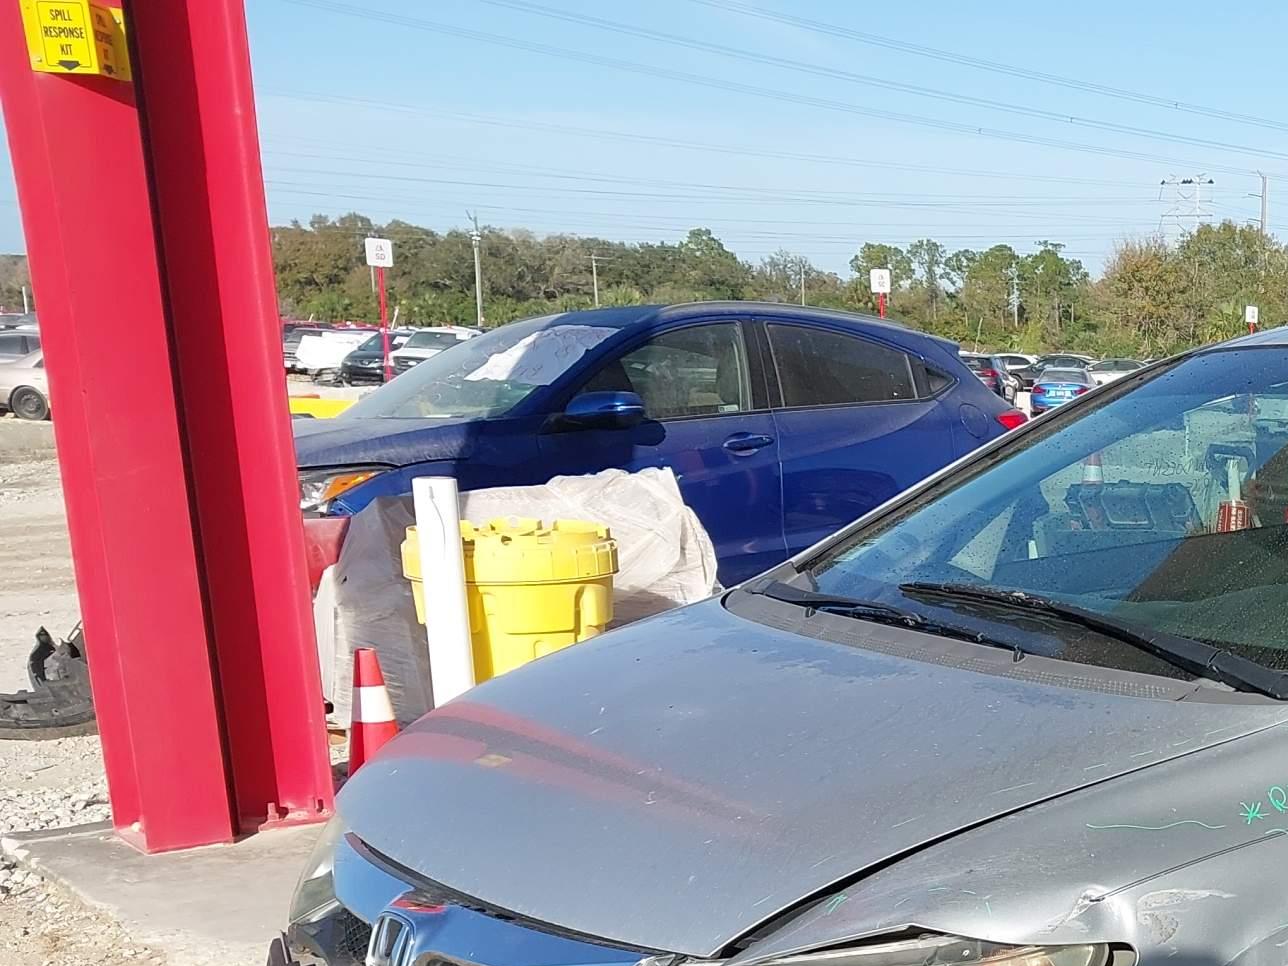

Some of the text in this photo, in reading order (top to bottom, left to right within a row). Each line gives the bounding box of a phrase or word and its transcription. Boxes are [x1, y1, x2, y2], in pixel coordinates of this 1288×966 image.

[49, 9, 73, 21] SPILL
[43, 26, 86, 39] RESPONSE
[59, 44, 73, 57] KIT
